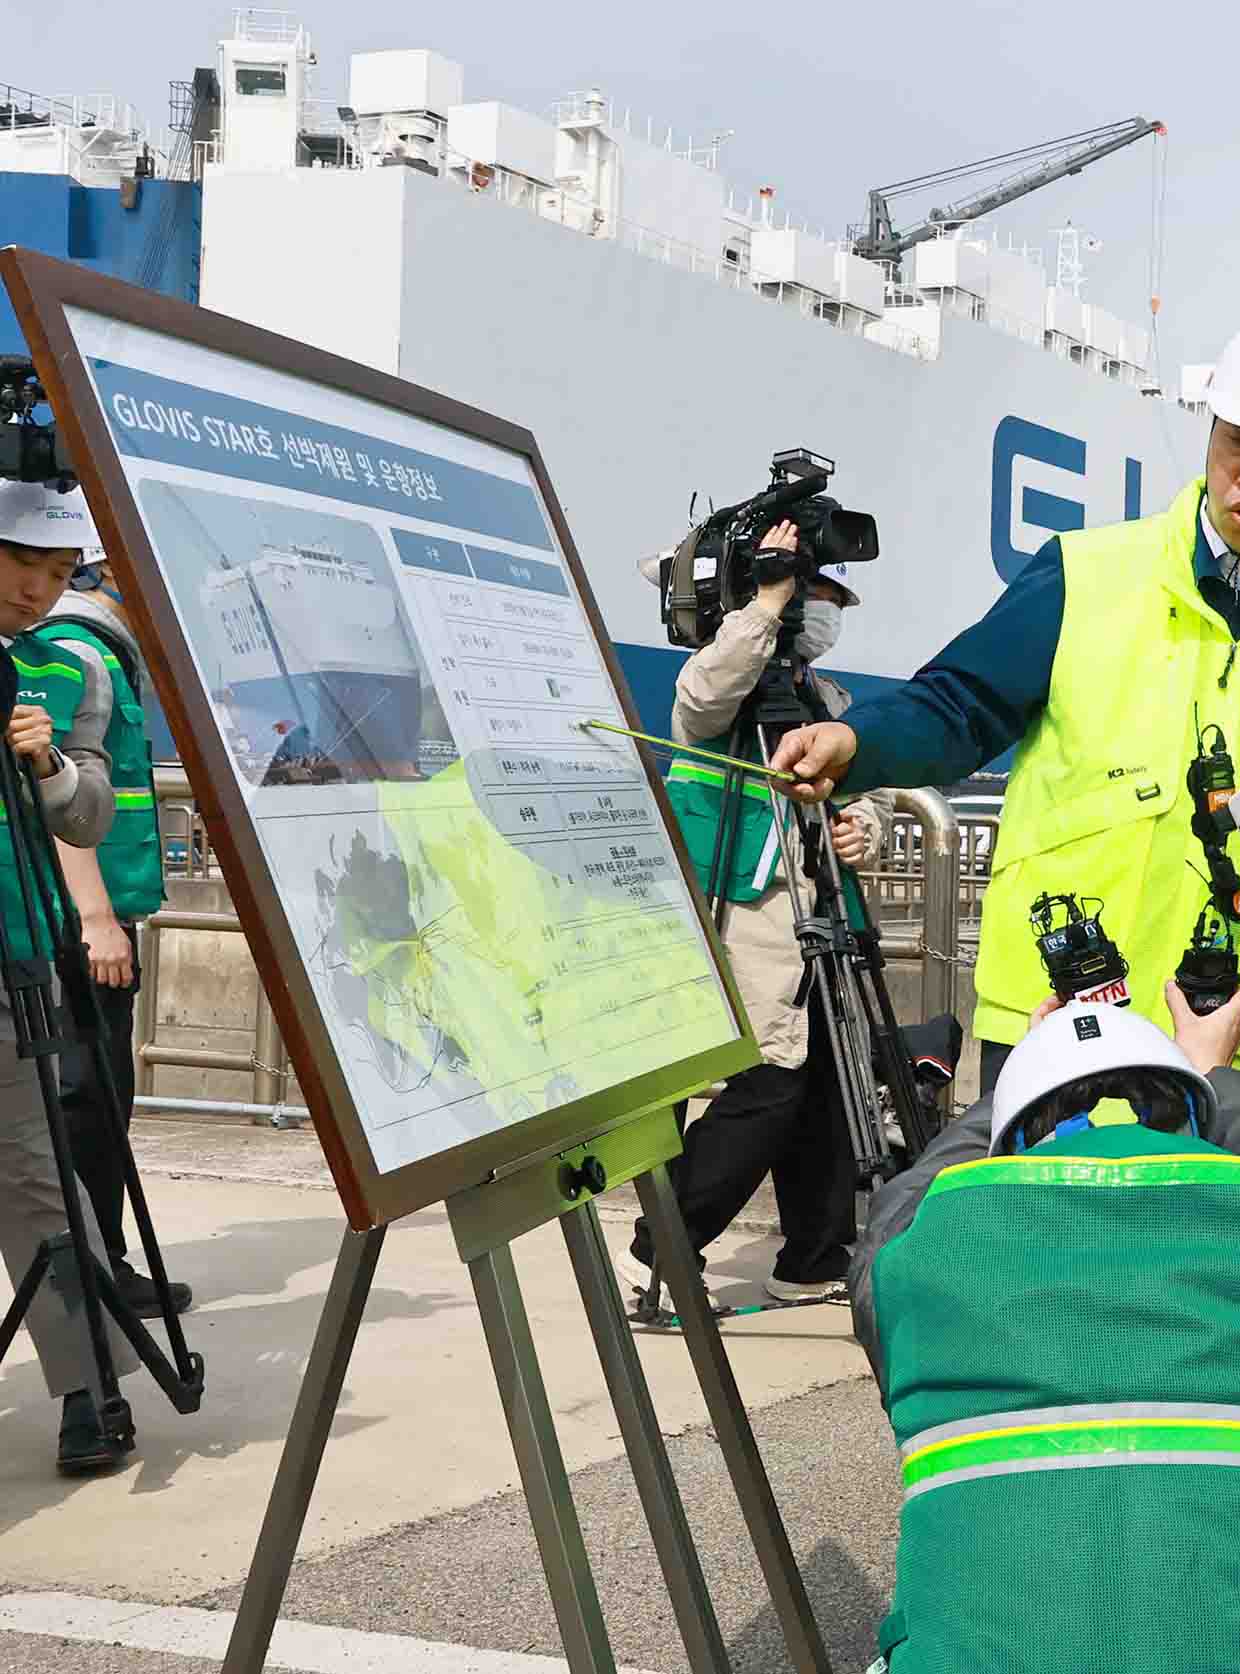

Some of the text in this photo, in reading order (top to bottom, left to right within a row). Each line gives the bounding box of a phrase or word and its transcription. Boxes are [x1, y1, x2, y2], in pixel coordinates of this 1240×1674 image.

[112, 394, 443, 501] GLOVIS STAR호 선박제원 및 운항정보
[1108, 768, 1125, 780] K2
